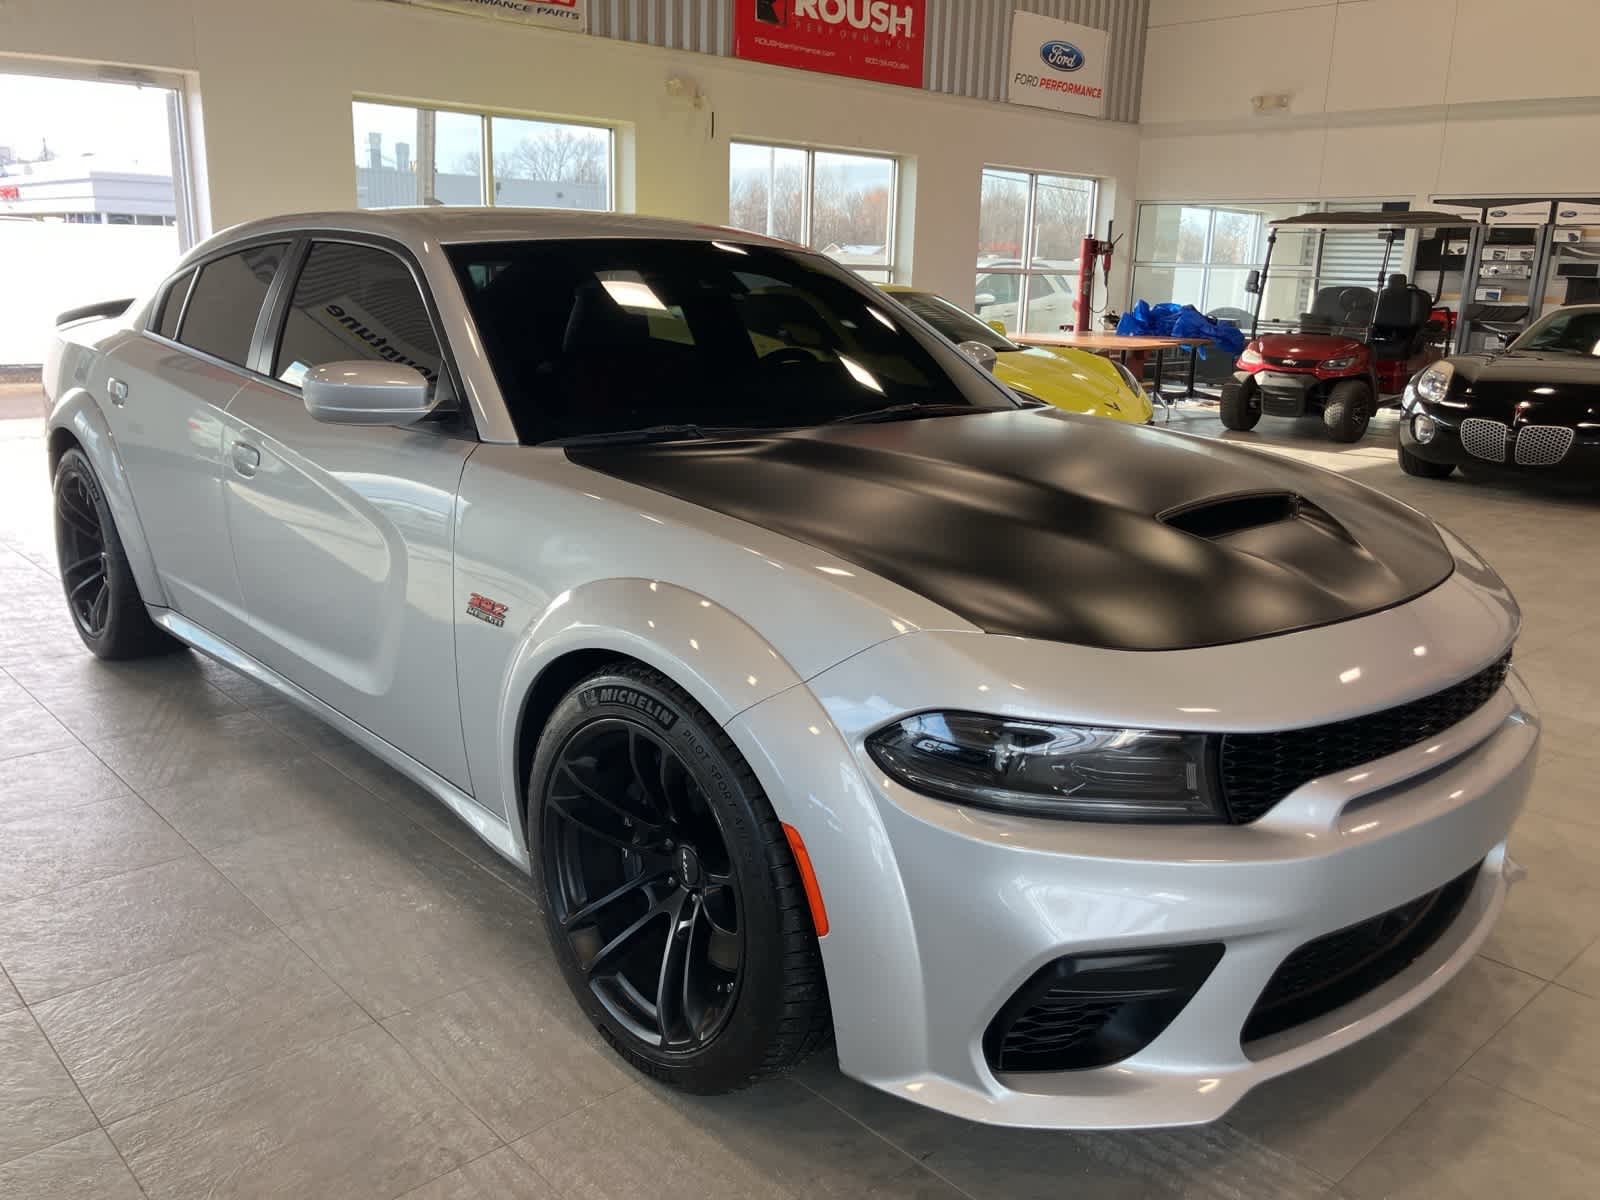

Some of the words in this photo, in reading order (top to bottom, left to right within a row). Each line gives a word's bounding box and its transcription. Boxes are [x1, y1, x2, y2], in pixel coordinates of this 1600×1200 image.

[536, 7, 579, 19] PARTS
[795, 0, 913, 37] ROUSH
[1048, 44, 1077, 67] Ford
[1014, 73, 1039, 88] FORD
[1039, 78, 1102, 98] PERFORMANCE
[600, 688, 673, 725] MICHELIN
[683, 729, 711, 761] PILOT
[711, 764, 737, 807] SPORT
